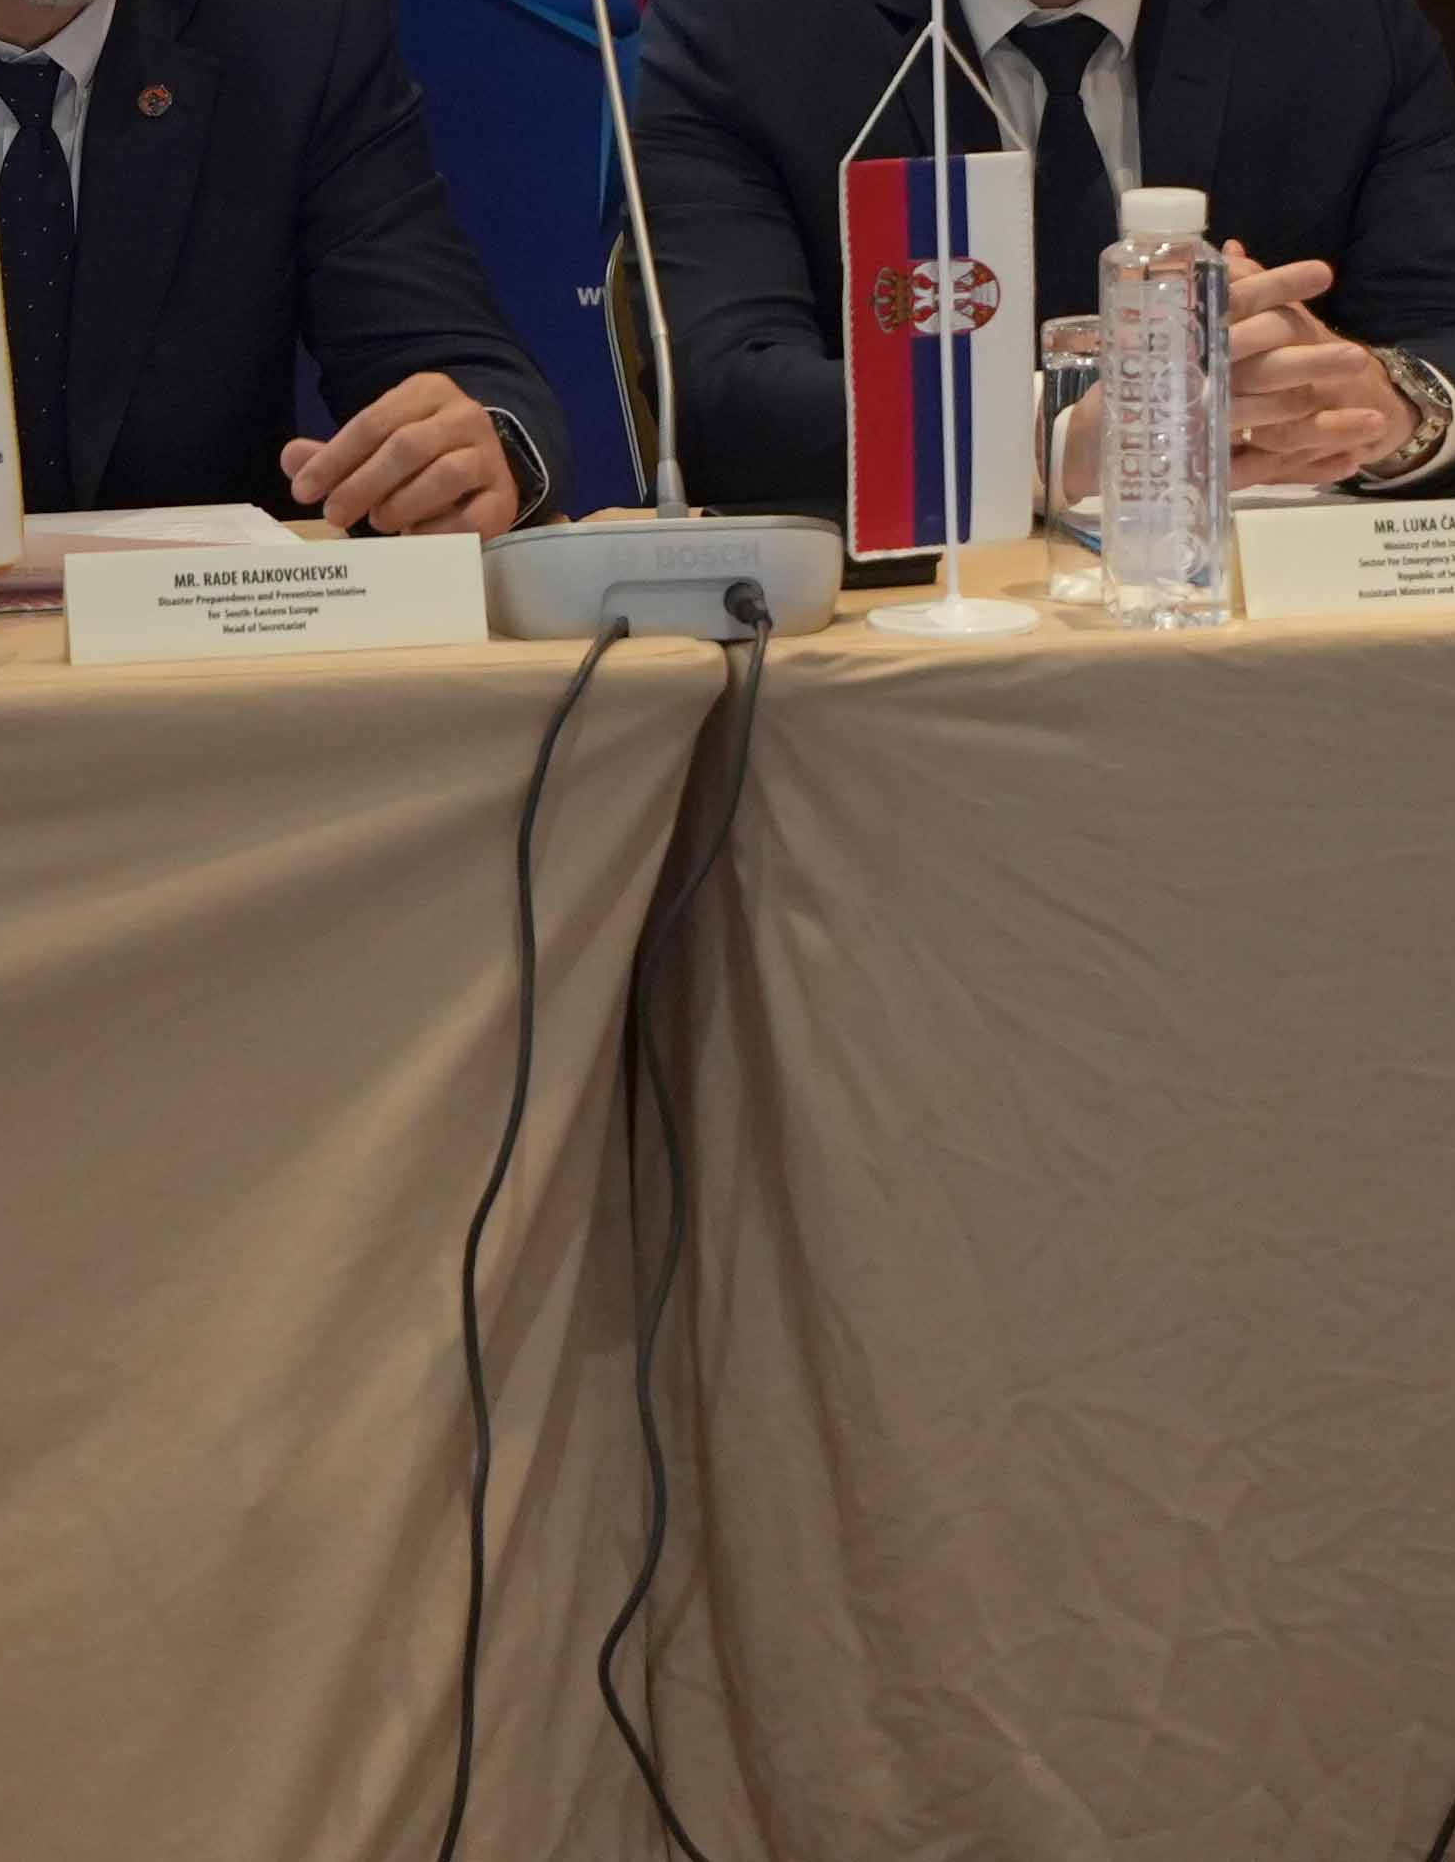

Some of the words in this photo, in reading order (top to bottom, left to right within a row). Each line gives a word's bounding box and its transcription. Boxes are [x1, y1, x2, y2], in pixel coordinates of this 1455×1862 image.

[1374, 519, 1400, 534] MR.
[1403, 518, 1437, 533] LUKA
[1358, 558, 1386, 568] Sector
[1402, 555, 1450, 566] Emergency
[174, 572, 199, 589] MR.
[203, 570, 239, 587] RADE
[242, 564, 348, 585] RAJKOVCHEVSKI
[158, 597, 194, 607] Disaster
[196, 594, 255, 606] Preparedness
[257, 591, 274, 601] and
[276, 589, 324, 601] Prevention
[326, 586, 367, 597] Initiative
[289, 605, 319, 617] Europe
[223, 623, 245, 634] Head
[247, 622, 256, 633] of
[258, 620, 306, 632] Secretariat
